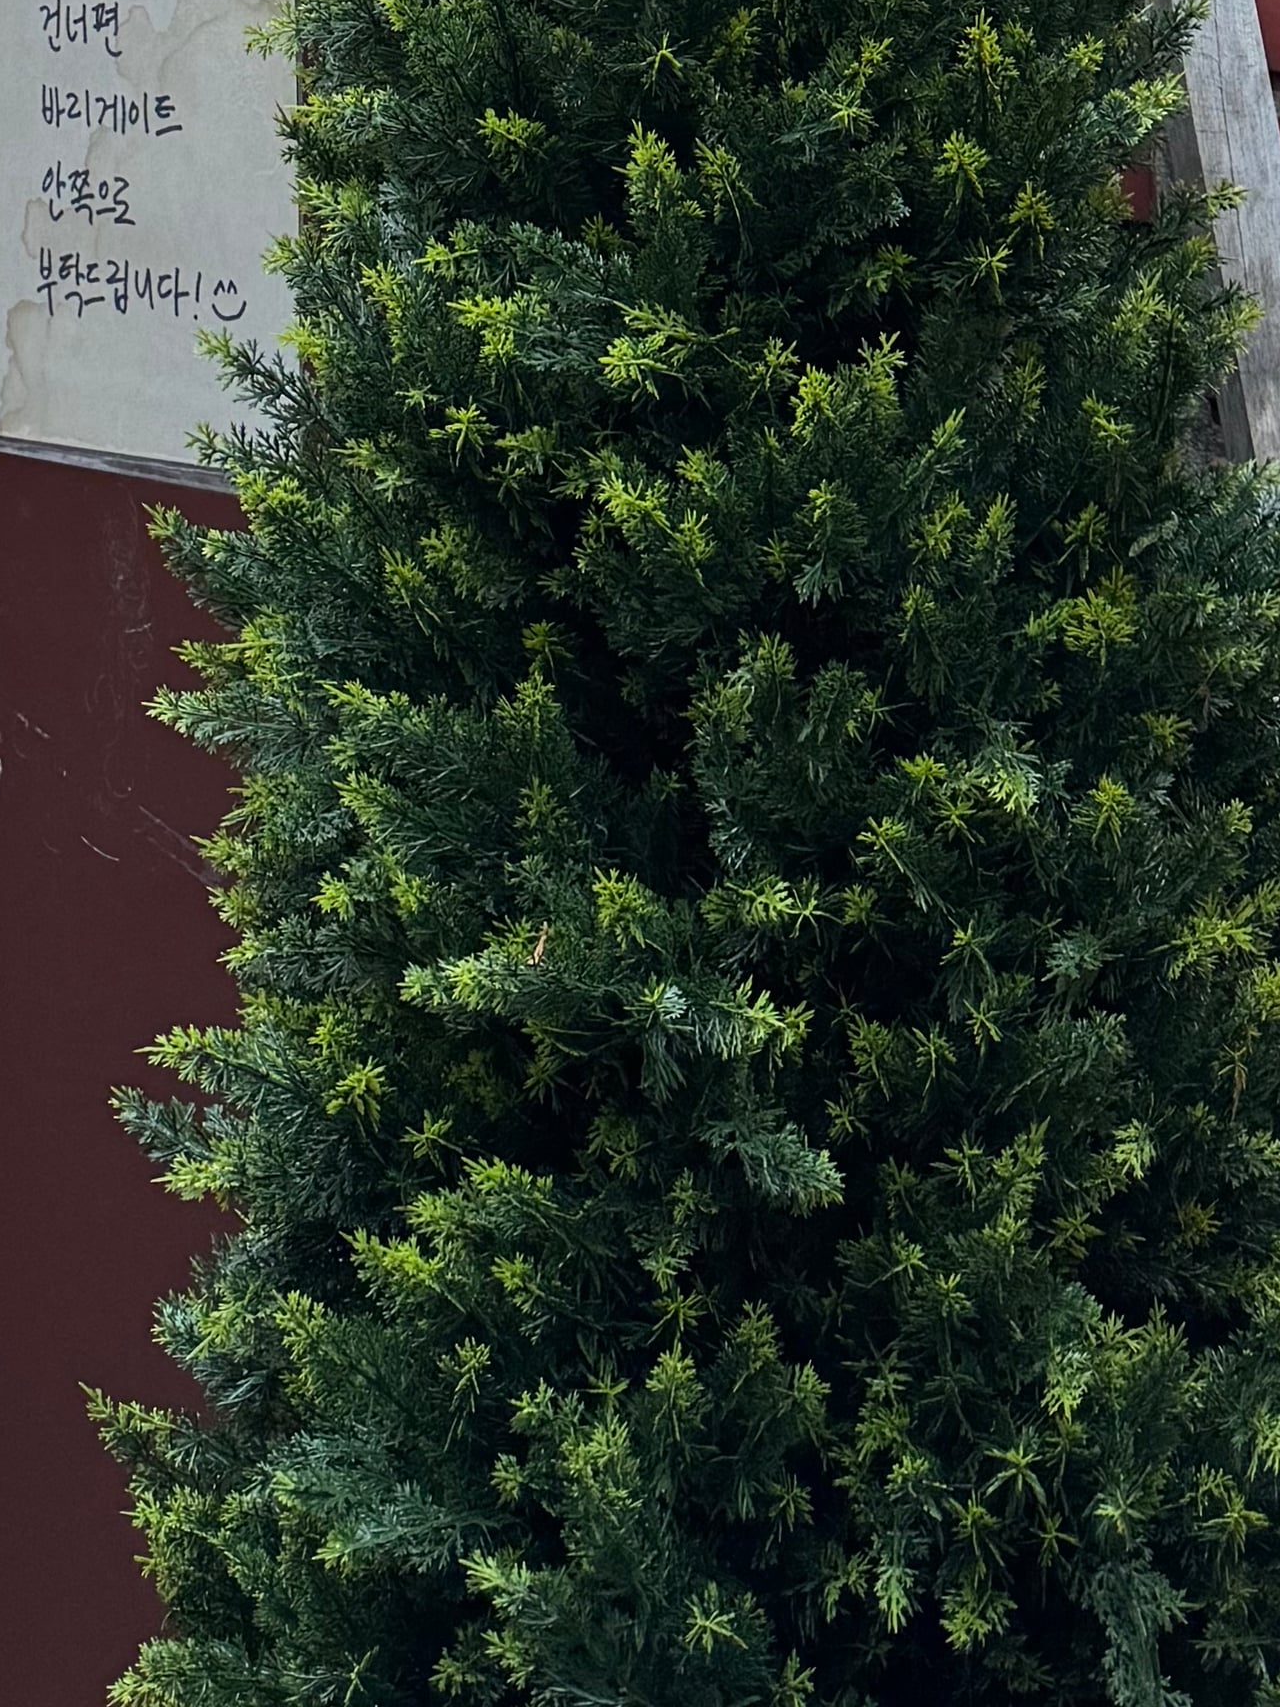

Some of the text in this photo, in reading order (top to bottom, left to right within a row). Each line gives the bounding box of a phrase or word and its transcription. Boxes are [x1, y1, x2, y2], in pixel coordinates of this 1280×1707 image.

[42, 84, 183, 136] 바리게이트
[42, 159, 136, 225] 안쪽으로
[37, 247, 203, 320] 부탁드립니다!
